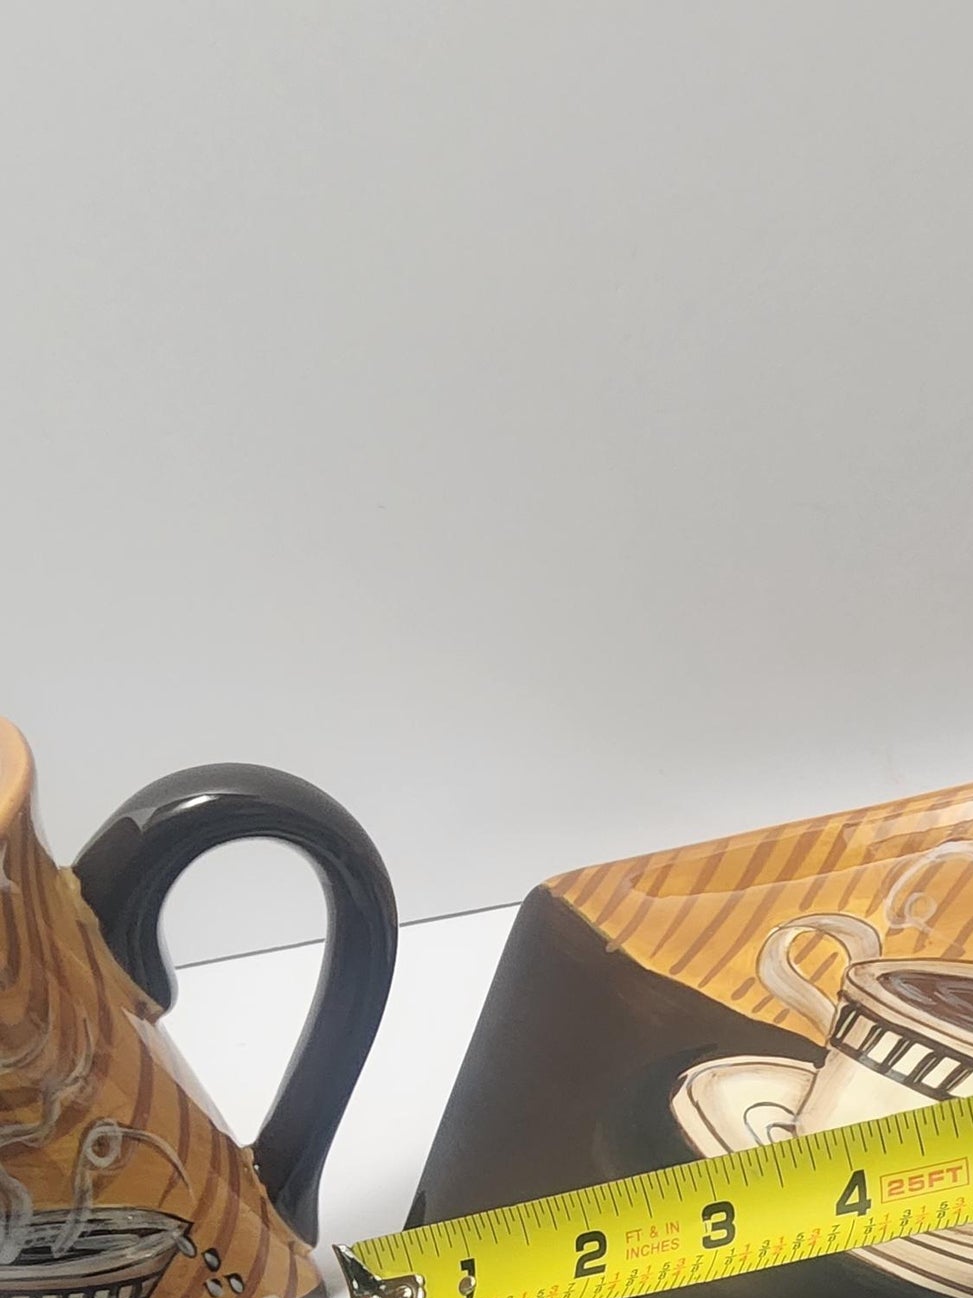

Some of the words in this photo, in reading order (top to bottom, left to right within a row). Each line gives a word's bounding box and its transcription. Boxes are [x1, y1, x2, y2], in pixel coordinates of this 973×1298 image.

[887, 1165, 963, 1196] 25FT
[574, 1230, 607, 1279] 2
[701, 1201, 735, 1249] 3
[835, 1169, 872, 1216] 4
[625, 1228, 643, 1244] FT
[650, 1225, 659, 1238] &
[665, 1221, 680, 1235] IN
[626, 1237, 680, 1260] INCHES
